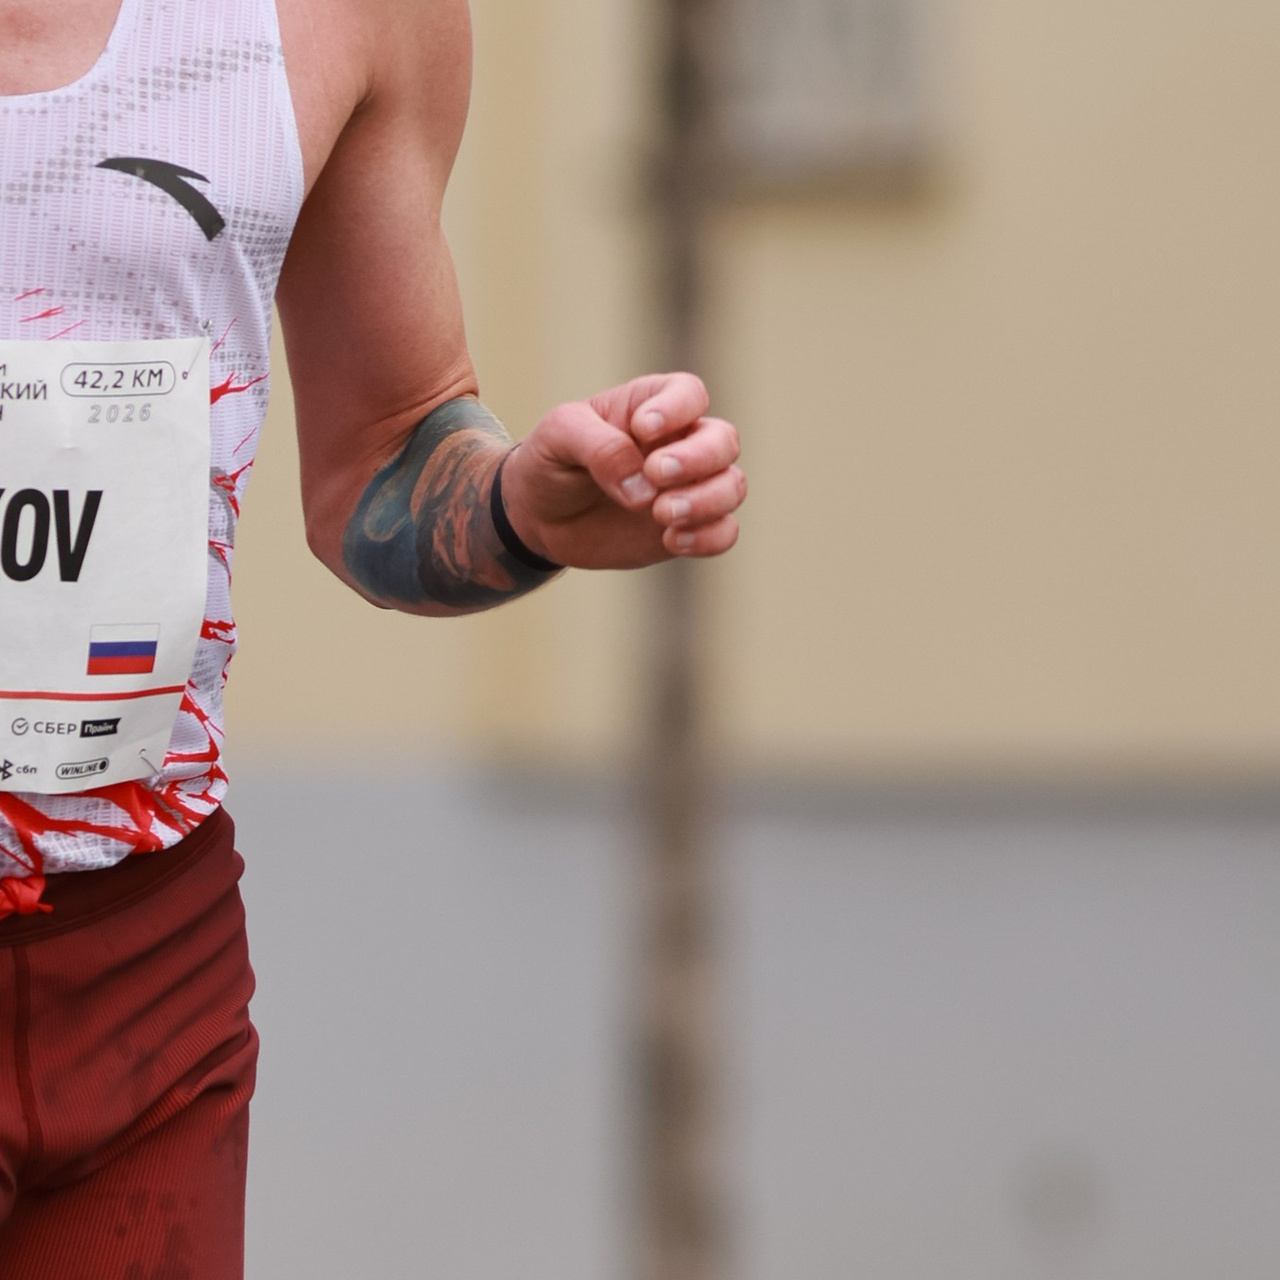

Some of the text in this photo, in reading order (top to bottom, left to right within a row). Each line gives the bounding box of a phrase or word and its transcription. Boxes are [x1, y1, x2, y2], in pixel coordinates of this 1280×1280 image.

[74, 370, 125, 392] 42,2
[87, 402, 152, 424] 2026
[33, 721, 77, 735] СБЕР
[16, 764, 38, 775] сбп
[60, 762, 99, 776] WINLINE
